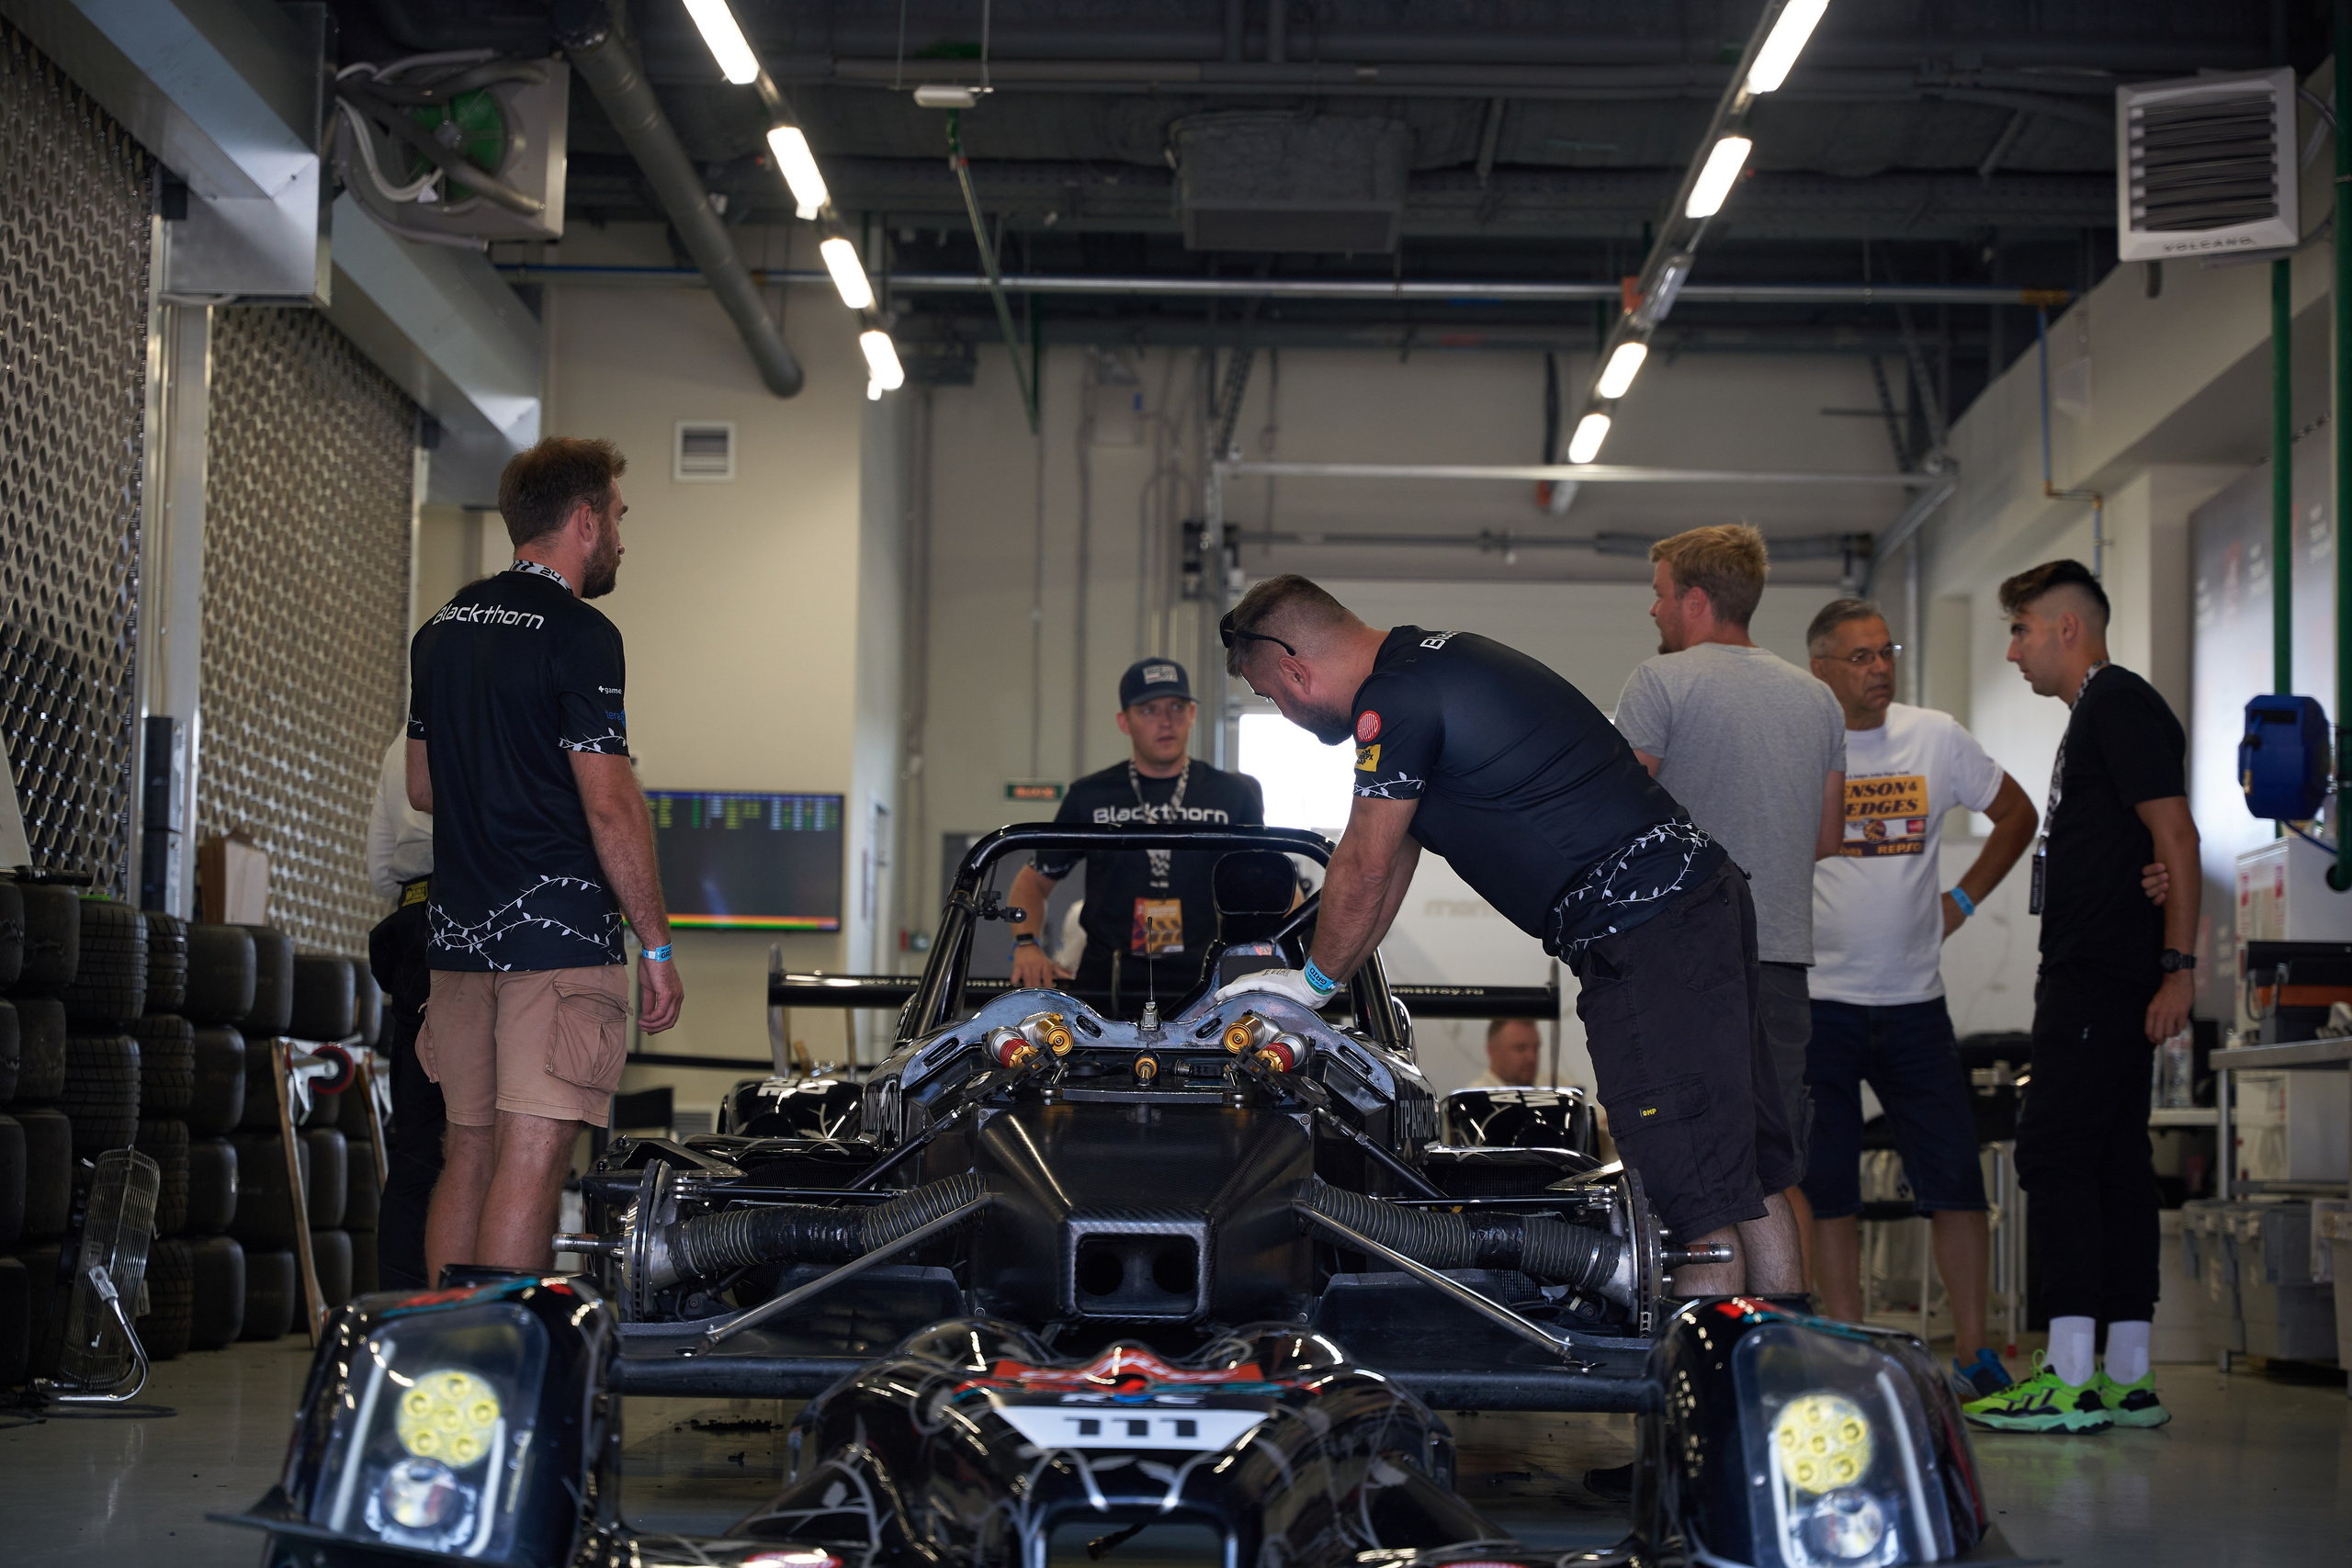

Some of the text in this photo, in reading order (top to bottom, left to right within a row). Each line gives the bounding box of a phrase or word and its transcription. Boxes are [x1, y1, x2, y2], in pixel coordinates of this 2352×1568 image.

[539, 567, 561, 581] 24
[432, 604, 545, 629] Blackthorn
[1846, 799, 1918, 816] EDGES
[1309, 967, 1327, 985] GRID
[1390, 987, 1484, 996] omstroy.ru
[1642, 1108, 1657, 1117] OMP
